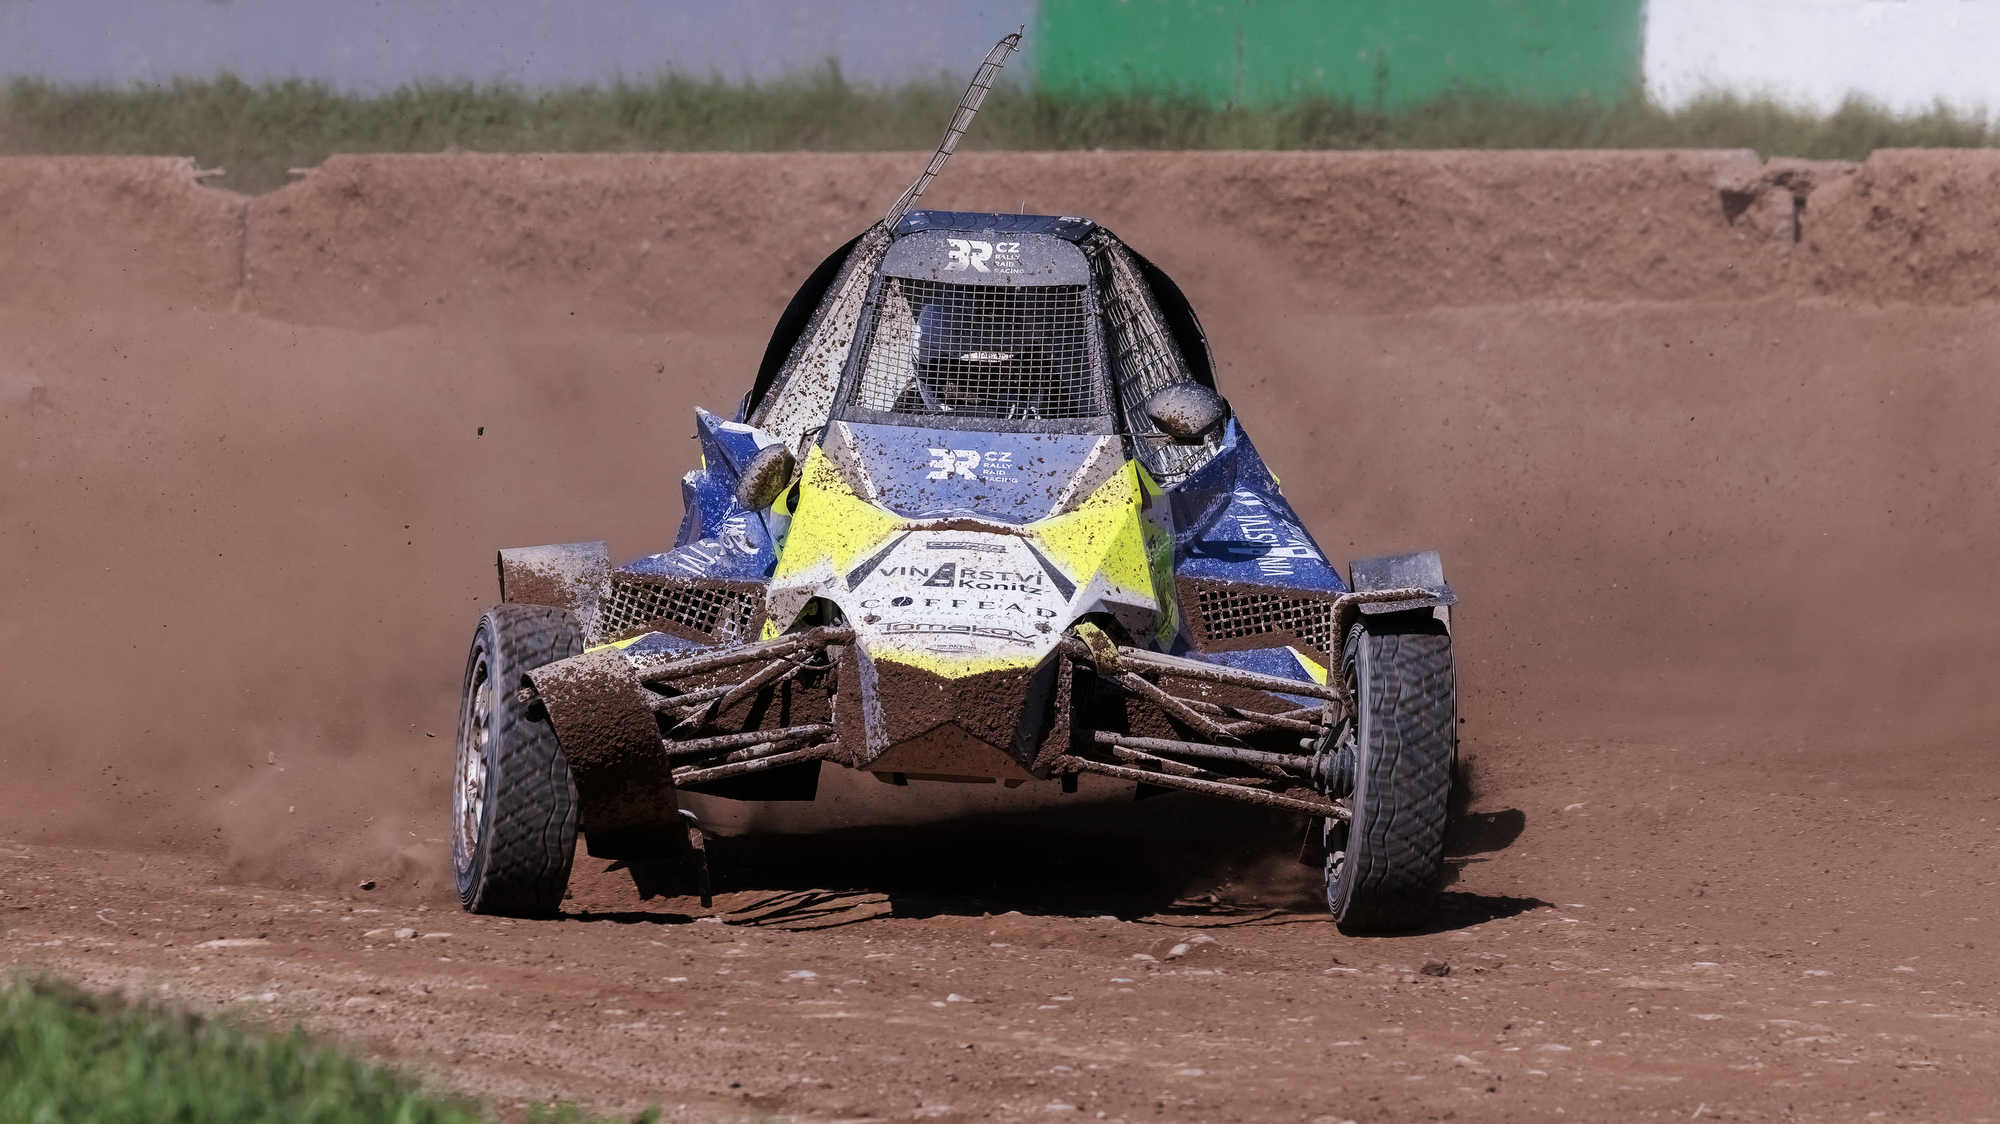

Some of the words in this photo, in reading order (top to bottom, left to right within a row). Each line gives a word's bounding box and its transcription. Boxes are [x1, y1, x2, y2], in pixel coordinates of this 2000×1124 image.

[995, 242, 1020, 253] CZ
[984, 451, 1012, 462] CZ
[959, 579, 1042, 596] Konitz
